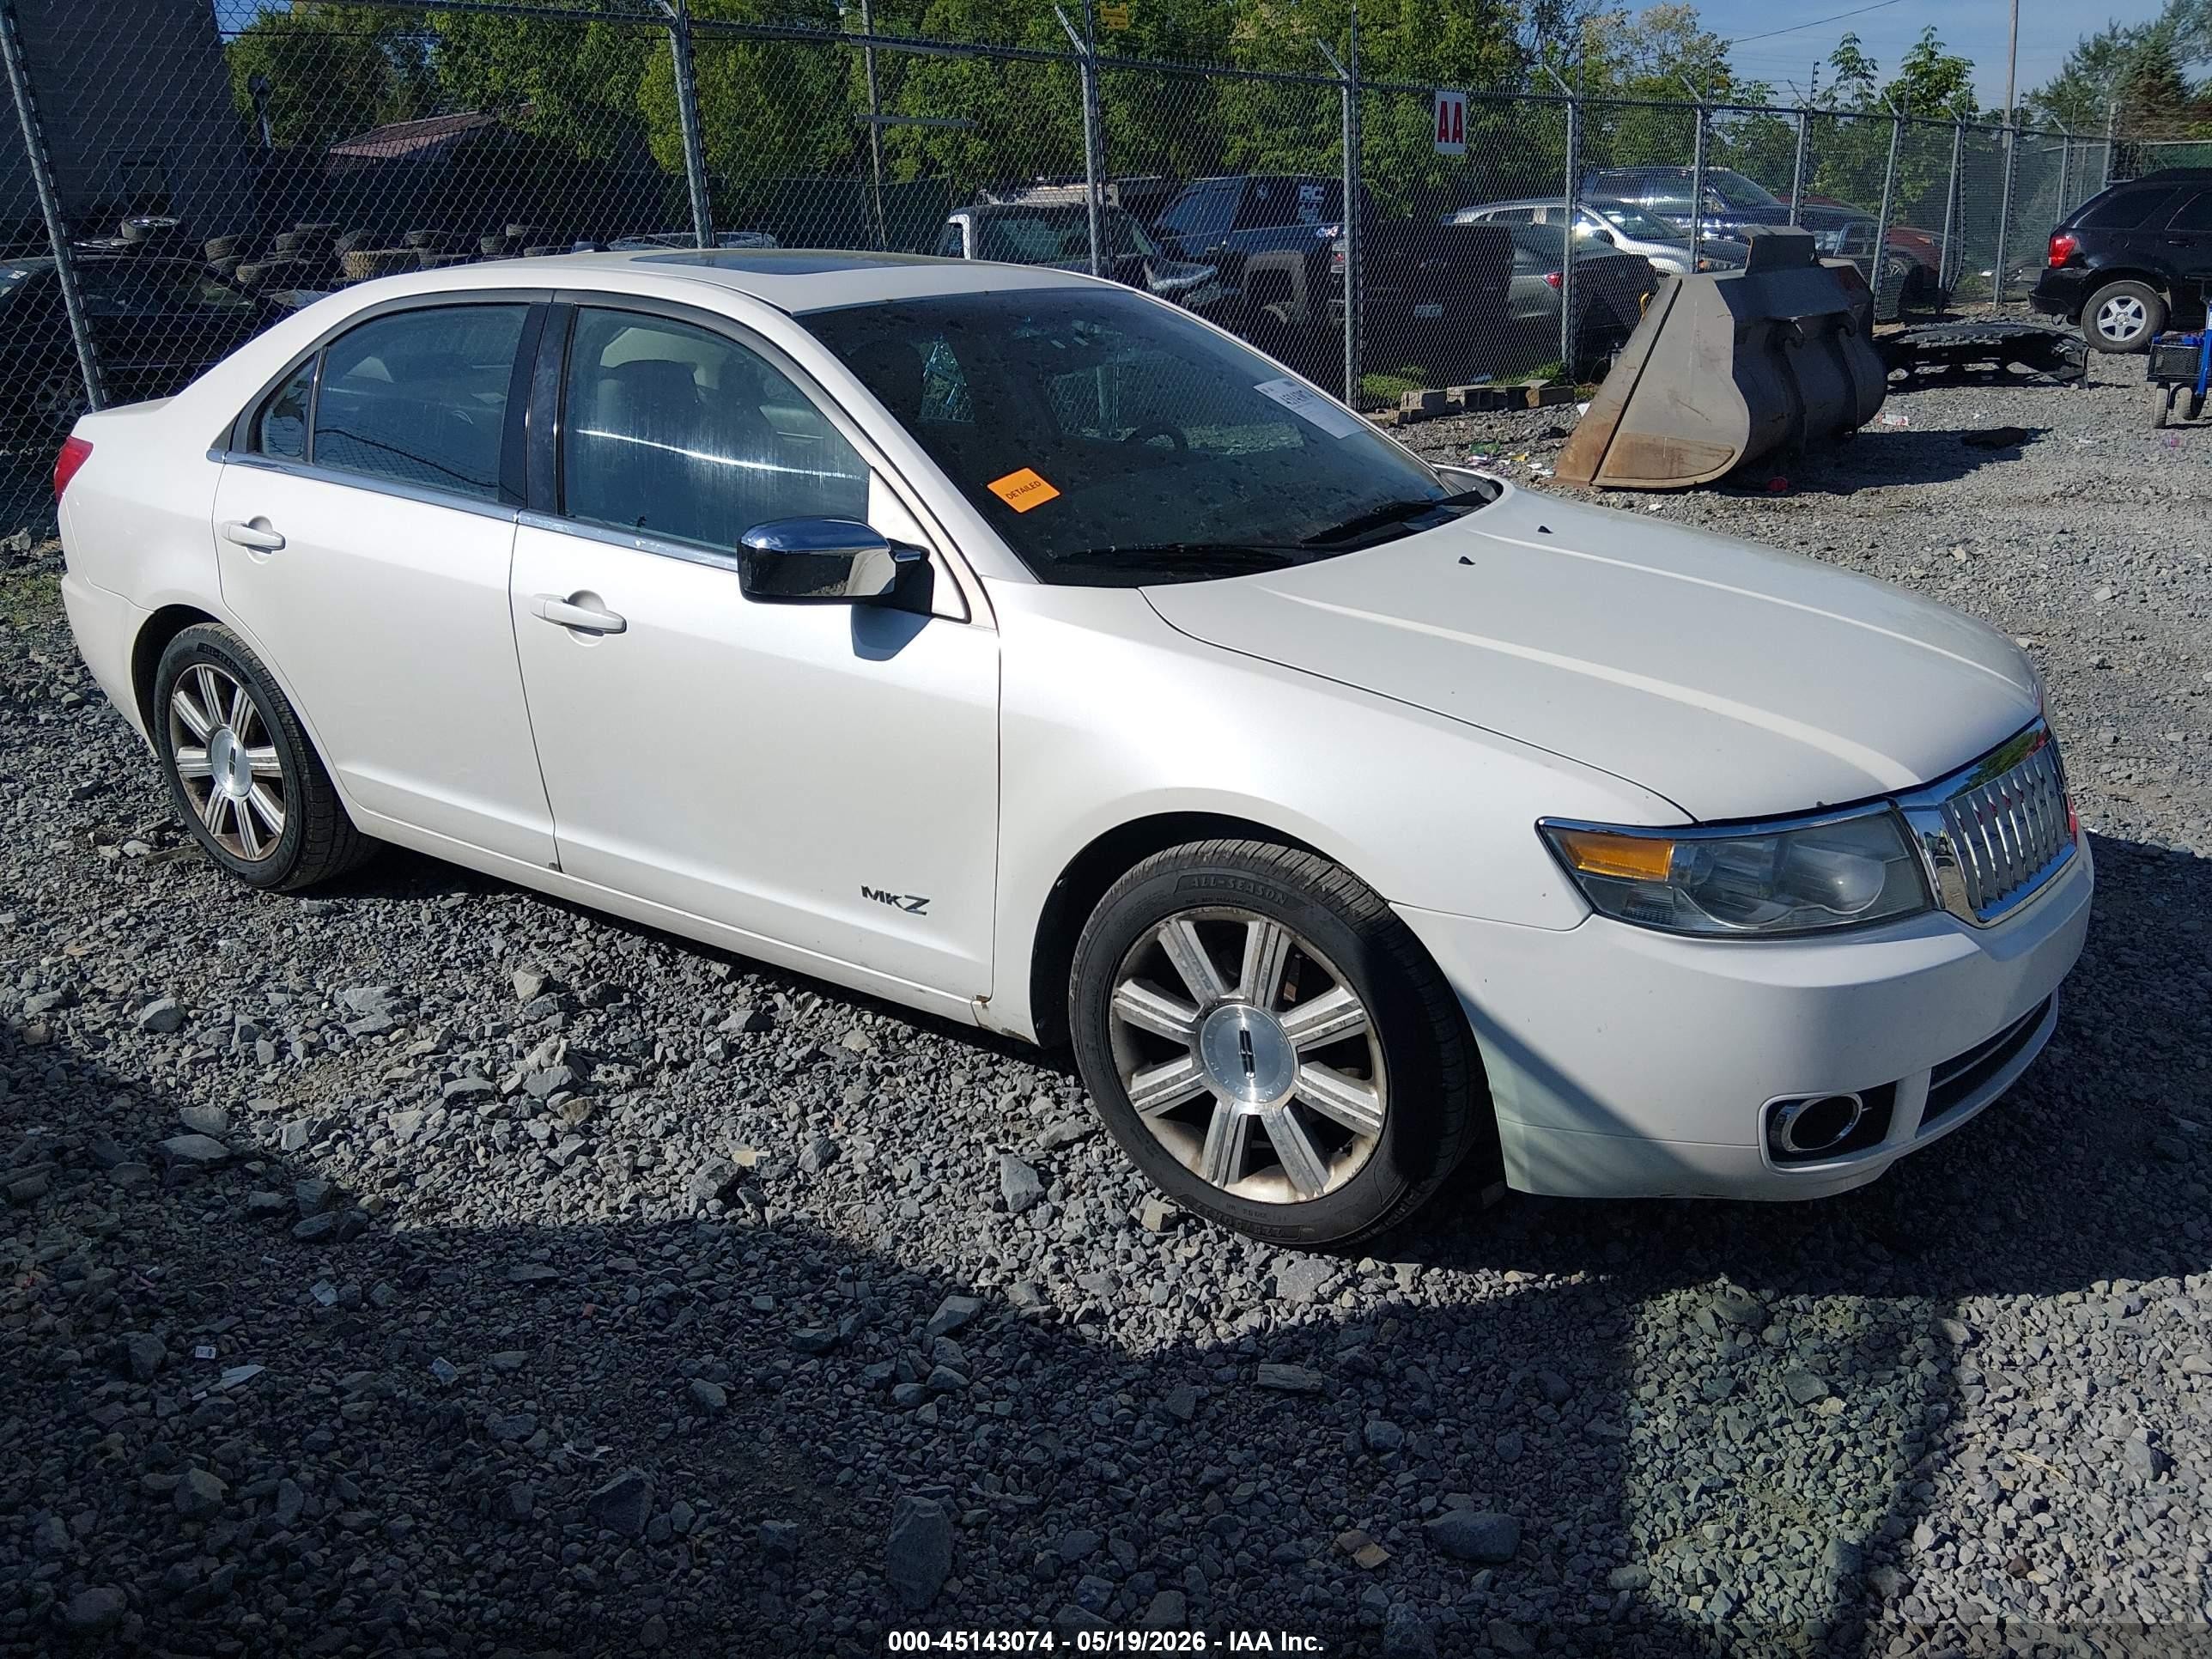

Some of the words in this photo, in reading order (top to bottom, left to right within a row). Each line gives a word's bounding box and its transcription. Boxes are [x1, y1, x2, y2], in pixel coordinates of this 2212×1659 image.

[1437, 100, 1464, 144] AA
[1005, 480, 1042, 501] DETAILED
[860, 885, 931, 916] MKZ
[1190, 874, 1290, 906] ALL-SEASON
